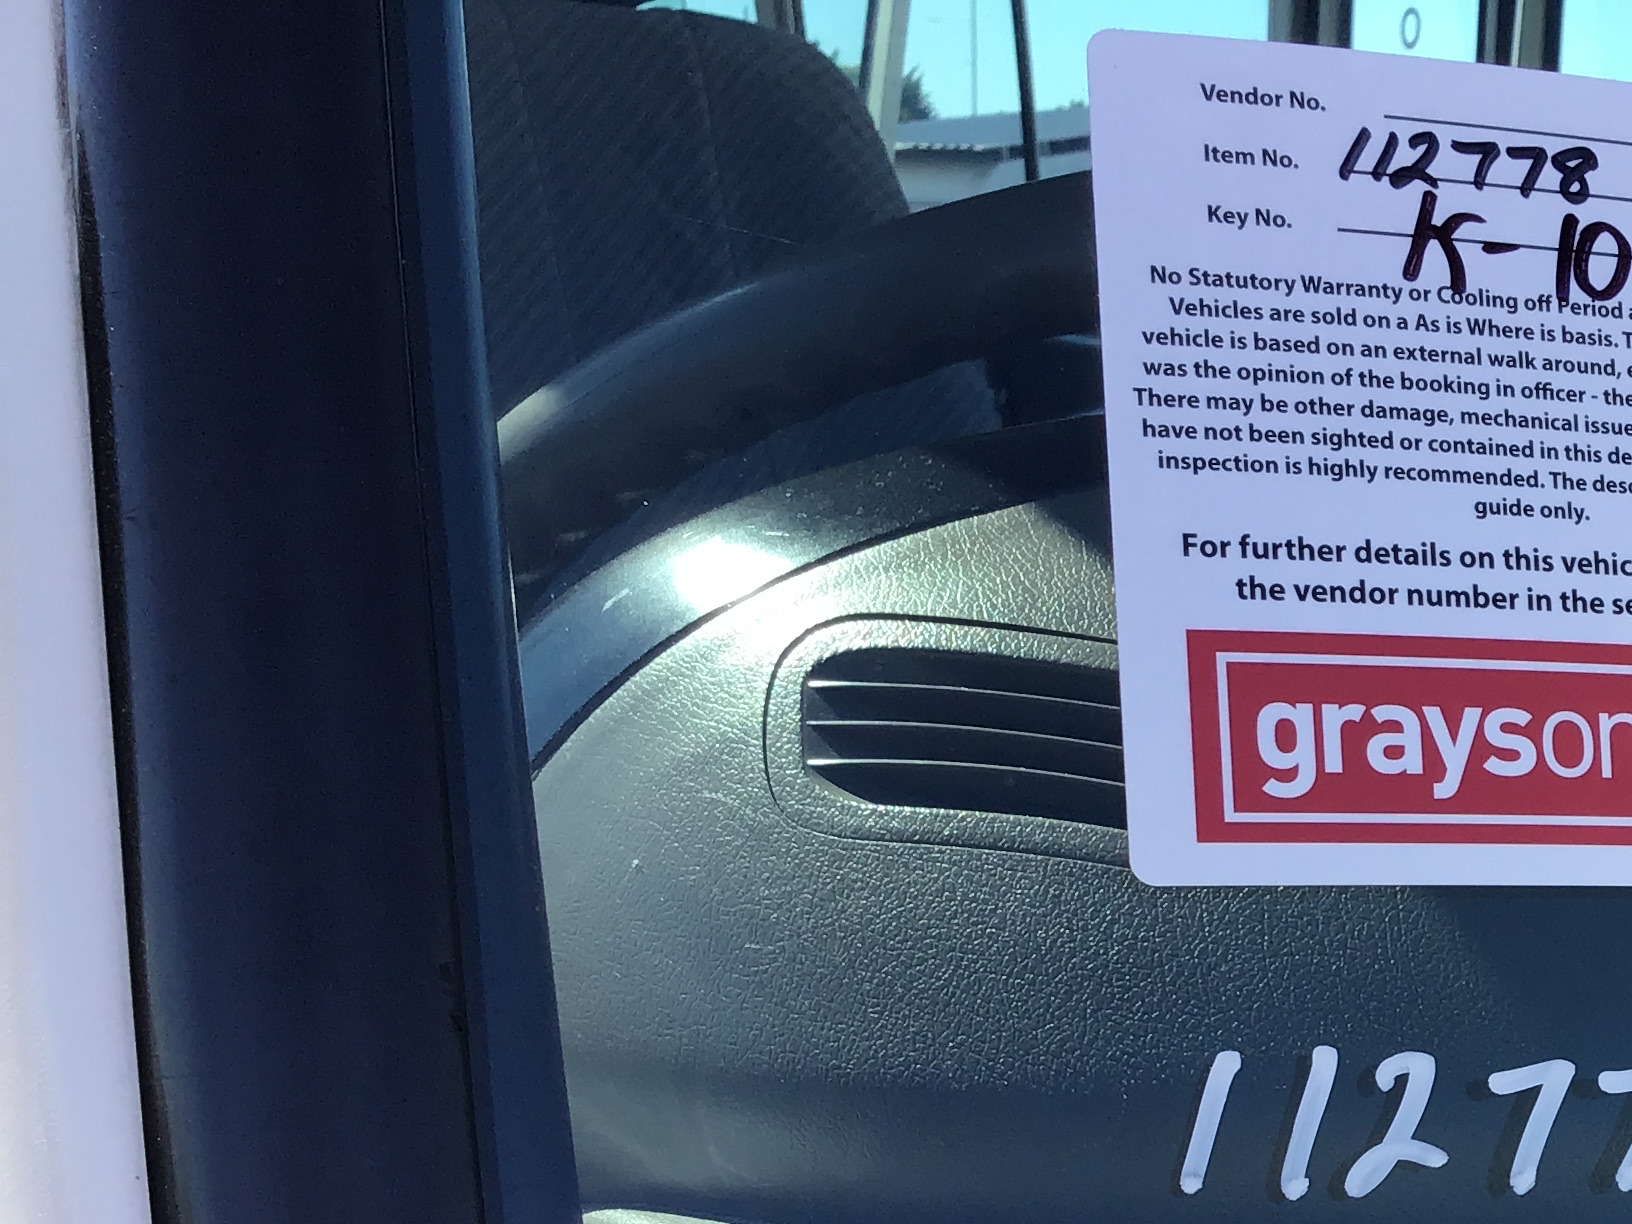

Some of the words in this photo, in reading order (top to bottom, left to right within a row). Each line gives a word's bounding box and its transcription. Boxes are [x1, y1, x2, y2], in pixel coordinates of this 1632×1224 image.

[1198, 82, 1285, 108] Vendor
[1288, 89, 1327, 113] No.
[1203, 142, 1256, 167] Item
[1261, 147, 1300, 170] No.
[1338, 126, 1598, 204] 112778
[1206, 203, 1250, 231] Key
[1254, 207, 1293, 230] No.
[1149, 264, 1183, 286] No
[1187, 266, 1297, 297] Statutory
[1299, 273, 1404, 306] Warranty
[1407, 287, 1433, 303] or
[1437, 288, 1519, 318] Cooling
[1523, 292, 1554, 314] off
[1556, 300, 1624, 319] Period
[1167, 295, 1265, 321] Vehicles
[1268, 306, 1306, 324] are
[1310, 305, 1358, 328] sold
[1362, 313, 1392, 330] on
[1395, 316, 1409, 331] a
[1413, 312, 1441, 334] As
[1445, 319, 1464, 335] is
[1464, 316, 1536, 342] Where
[1539, 322, 1557, 343] is
[1560, 324, 1620, 349] basis.
[1140, 325, 1225, 350] vehicle
[1229, 329, 1249, 351] is
[1252, 330, 1322, 355] based
[1325, 341, 1356, 358] on
[1359, 343, 1388, 360] an
[1392, 344, 1483, 367] external
[1486, 349, 1539, 371] walk
[1541, 357, 1623, 381] around,
[1141, 361, 1189, 378] was
[1192, 358, 1232, 381] the
[1236, 362, 1326, 387] opinion
[1329, 366, 1354, 387] of
[1357, 368, 1396, 390] the
[1399, 370, 1491, 402] booking
[1495, 382, 1516, 399] in
[1519, 380, 1587, 404] officer
[1131, 386, 1201, 410] There
[1205, 395, 1255, 418] may
[1259, 392, 1290, 415] be
[1293, 395, 1356, 418] other
[1359, 398, 1455, 428] damage,
[1459, 407, 1580, 433] mechanical
[1141, 417, 1199, 441] have
[1203, 424, 1244, 443] not
[1247, 422, 1306, 446] been
[1310, 426, 1395, 453] sighted
[1398, 436, 1424, 452] or
[1427, 436, 1535, 459] contained
[1539, 439, 1560, 461] in
[1563, 442, 1603, 464] this
[1157, 448, 1280, 476] inspection
[1284, 454, 1303, 476] is
[1307, 455, 1379, 485] highly
[1383, 465, 1546, 490] recommended.
[1547, 470, 1588, 492] The
[1473, 496, 1536, 521] guide
[1539, 500, 1591, 526] only.
[1181, 532, 1232, 559] For
[1237, 532, 1348, 563] further
[1353, 537, 1453, 568] details
[1458, 550, 1496, 570] on
[1501, 545, 1555, 573] this
[1234, 574, 1287, 602] the
[1292, 578, 1400, 606] vendor
[1406, 582, 1520, 611] number
[1526, 586, 1553, 613] in
[1558, 587, 1606, 615] the
